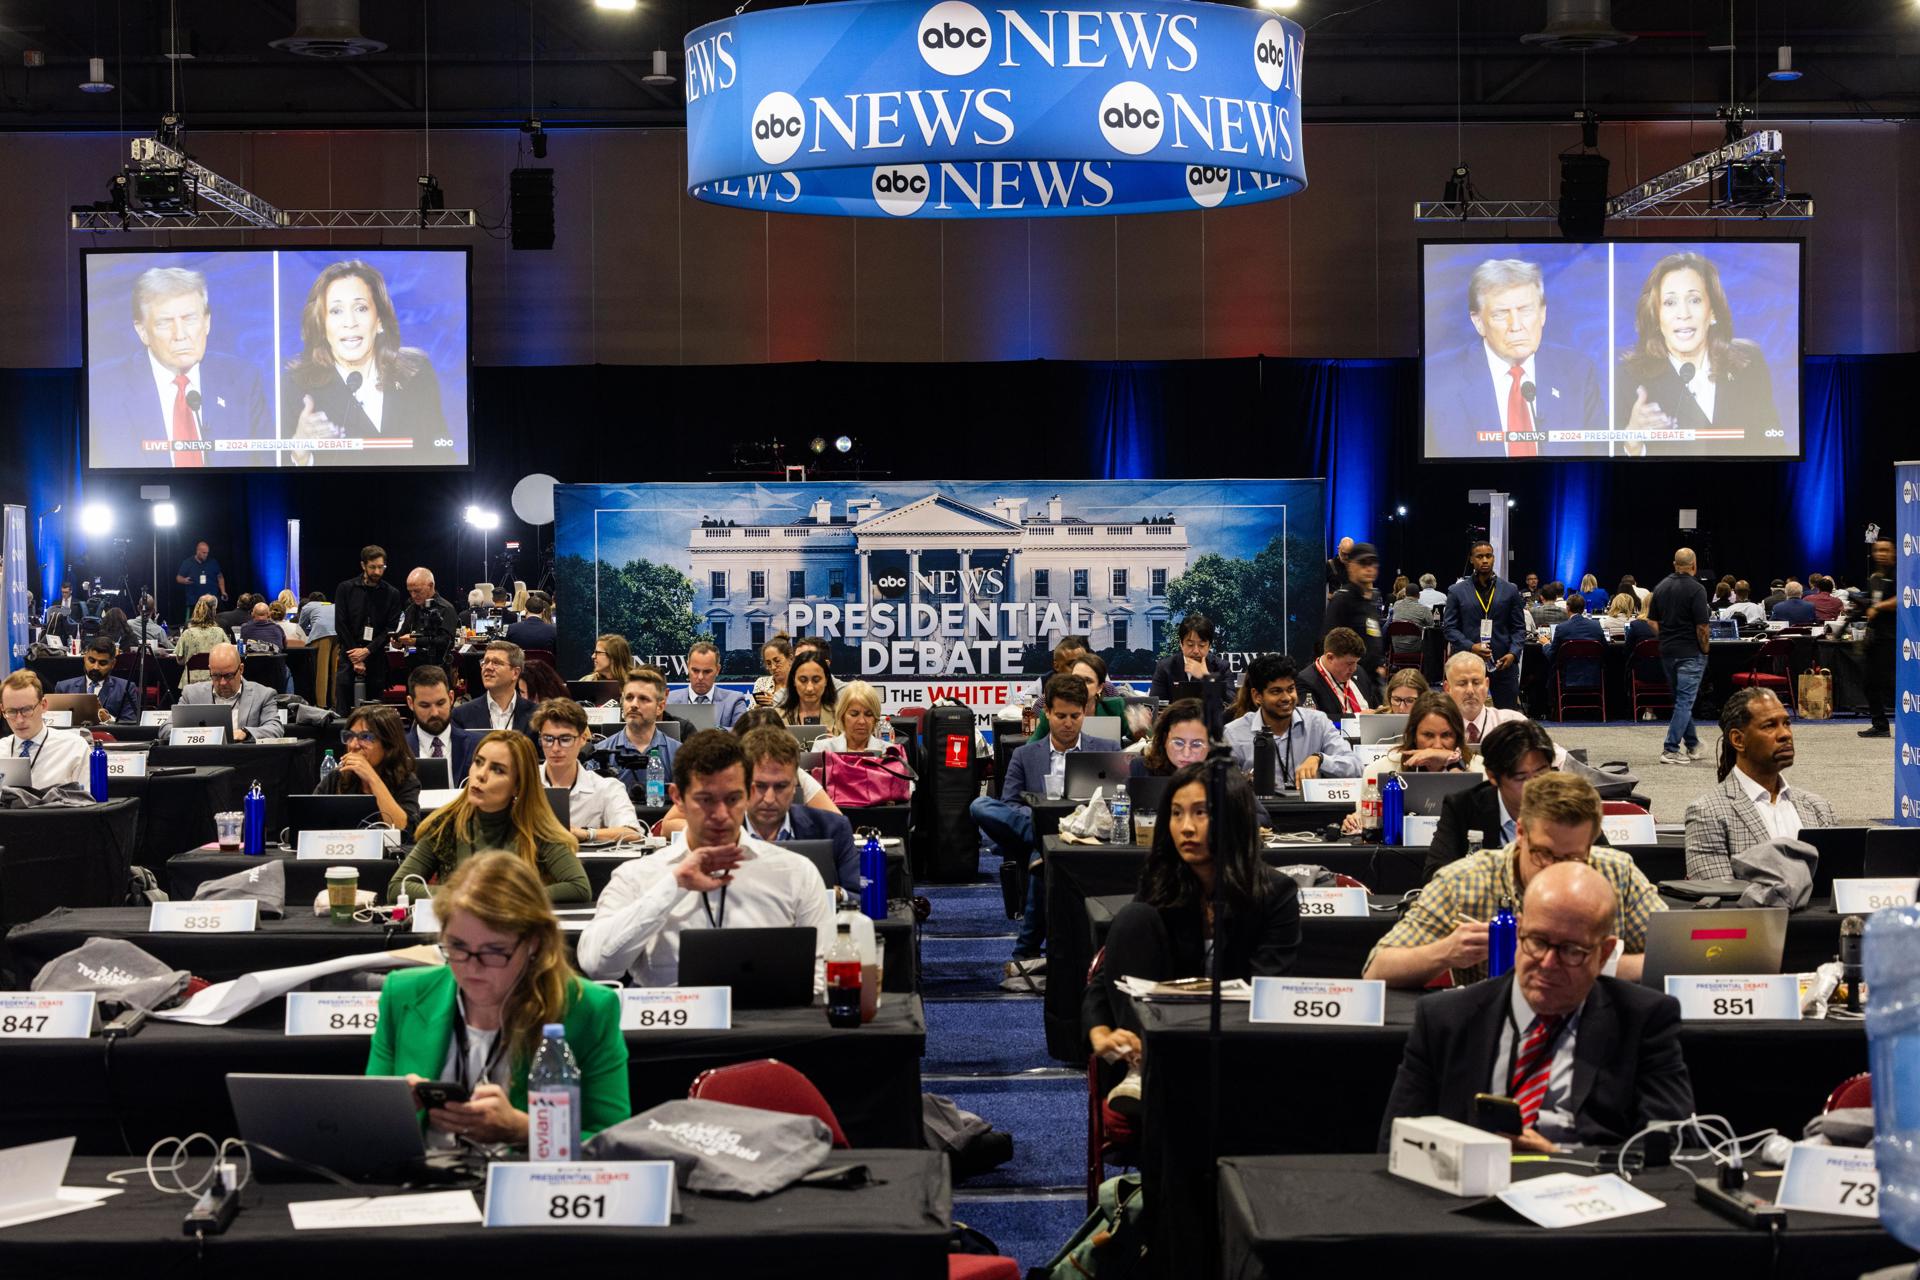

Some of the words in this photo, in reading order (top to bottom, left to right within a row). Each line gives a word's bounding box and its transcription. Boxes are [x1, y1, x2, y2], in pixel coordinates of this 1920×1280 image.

[923, 23, 987, 49] abc
[996, 10, 1198, 72] NEWS
[1257, 39, 1284, 68] abc
[686, 31, 737, 104] EWS
[755, 114, 801, 140] abc
[809, 88, 1015, 152] NEWS
[1104, 103, 1160, 129] abc
[1166, 92, 1293, 162] NEWS
[1189, 166, 1228, 185] abc
[876, 169, 926, 193] abc
[934, 161, 1114, 210] NEWS
[434, 438, 454, 447] abc
[1480, 432, 1503, 441] LIVE
[1518, 432, 1546, 441] NEWS
[1560, 432, 1582, 440] 2024
[1584, 431, 1648, 440] PRESIDENTIAL
[1650, 431, 1685, 439] DEBATE
[1764, 429, 1784, 438] abc
[145, 442, 169, 450] LIVE
[184, 441, 212, 450] NEWS
[226, 441, 248, 449] 2024
[251, 440, 315, 449] PRESIDENTIAL
[318, 440, 352, 448] DEBATE
[879, 575, 907, 588] abc
[910, 569, 1004, 595] NEWS
[788, 602, 1091, 638] PRESIDENTIAL
[631, 654, 689, 676] NEW
[860, 640, 1024, 675] DEBATE
[891, 689, 922, 703] THE
[927, 685, 1008, 705] WHITE
[187, 736, 205, 744] 786
[106, 765, 124, 774] 98
[1328, 790, 1350, 800] 815
[325, 844, 355, 856] 823
[1300, 903, 1335, 915] 838
[184, 917, 221, 929] 835
[1293, 1000, 1341, 1018] 850
[1713, 998, 1754, 1015] 851
[2, 1015, 49, 1033] 847
[329, 1013, 378, 1029] 848
[640, 1009, 688, 1026] 849
[536, 1108, 550, 1158] evian
[529, 1173, 593, 1181] PRESIDENTIAL
[595, 1172, 630, 1181] DEBATE
[1839, 1181, 1877, 1207] 73
[548, 1194, 607, 1219] 861
